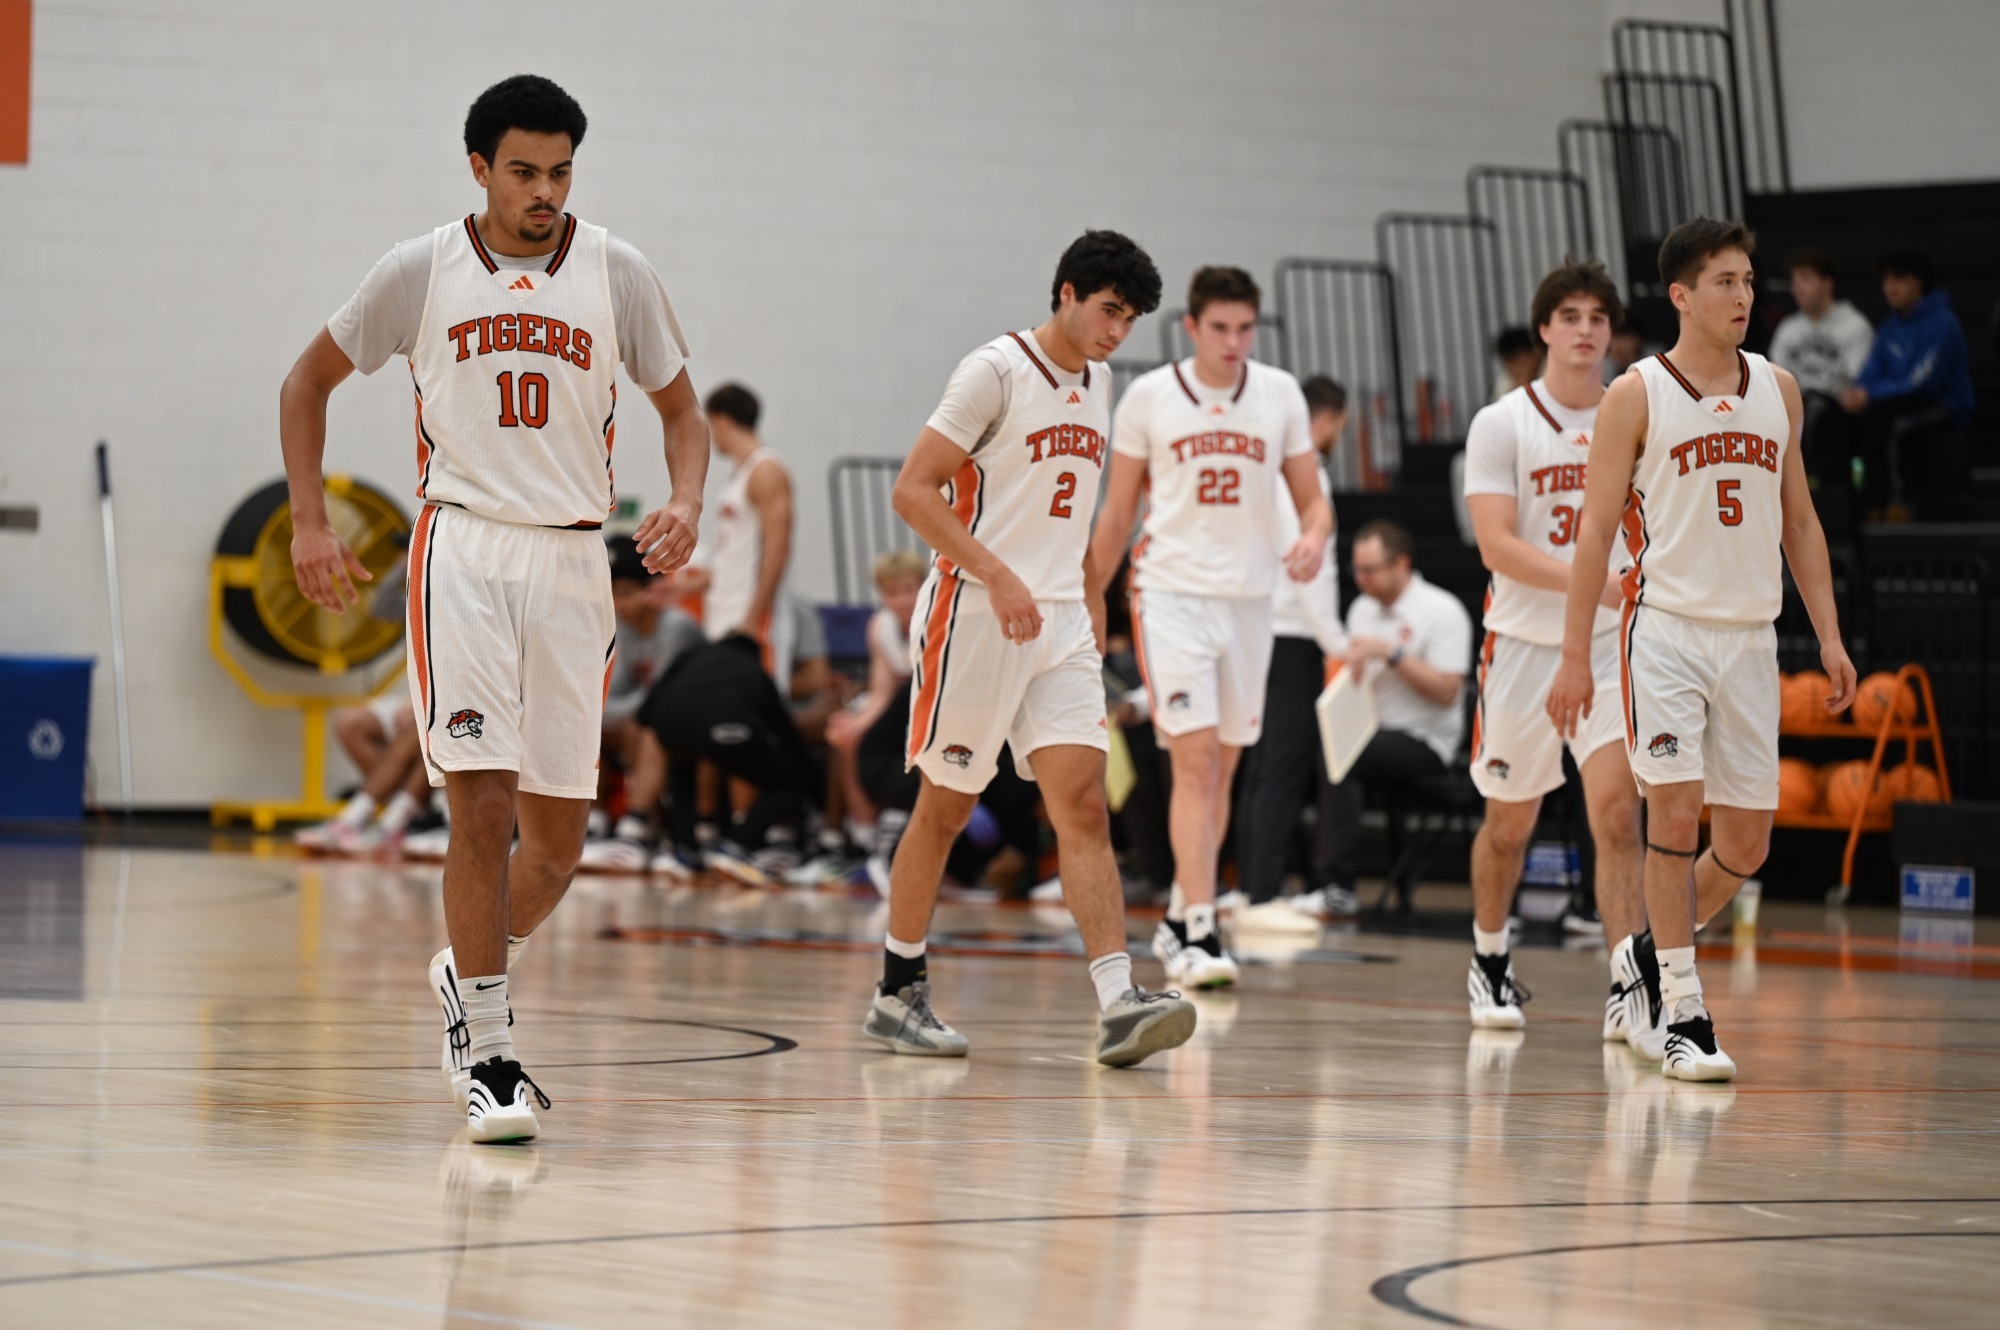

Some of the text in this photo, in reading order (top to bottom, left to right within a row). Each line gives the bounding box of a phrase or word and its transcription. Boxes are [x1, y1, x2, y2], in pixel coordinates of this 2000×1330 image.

[448, 313, 593, 371] TIGERS
[496, 371, 549, 429] 10
[1170, 431, 1267, 464] TIGERS
[1670, 432, 1779, 476] TIGERS
[1049, 471, 1077, 519] 2
[1197, 469, 1240, 505] 22
[1530, 463, 1588, 496] TIGE
[1716, 479, 1743, 526] 5
